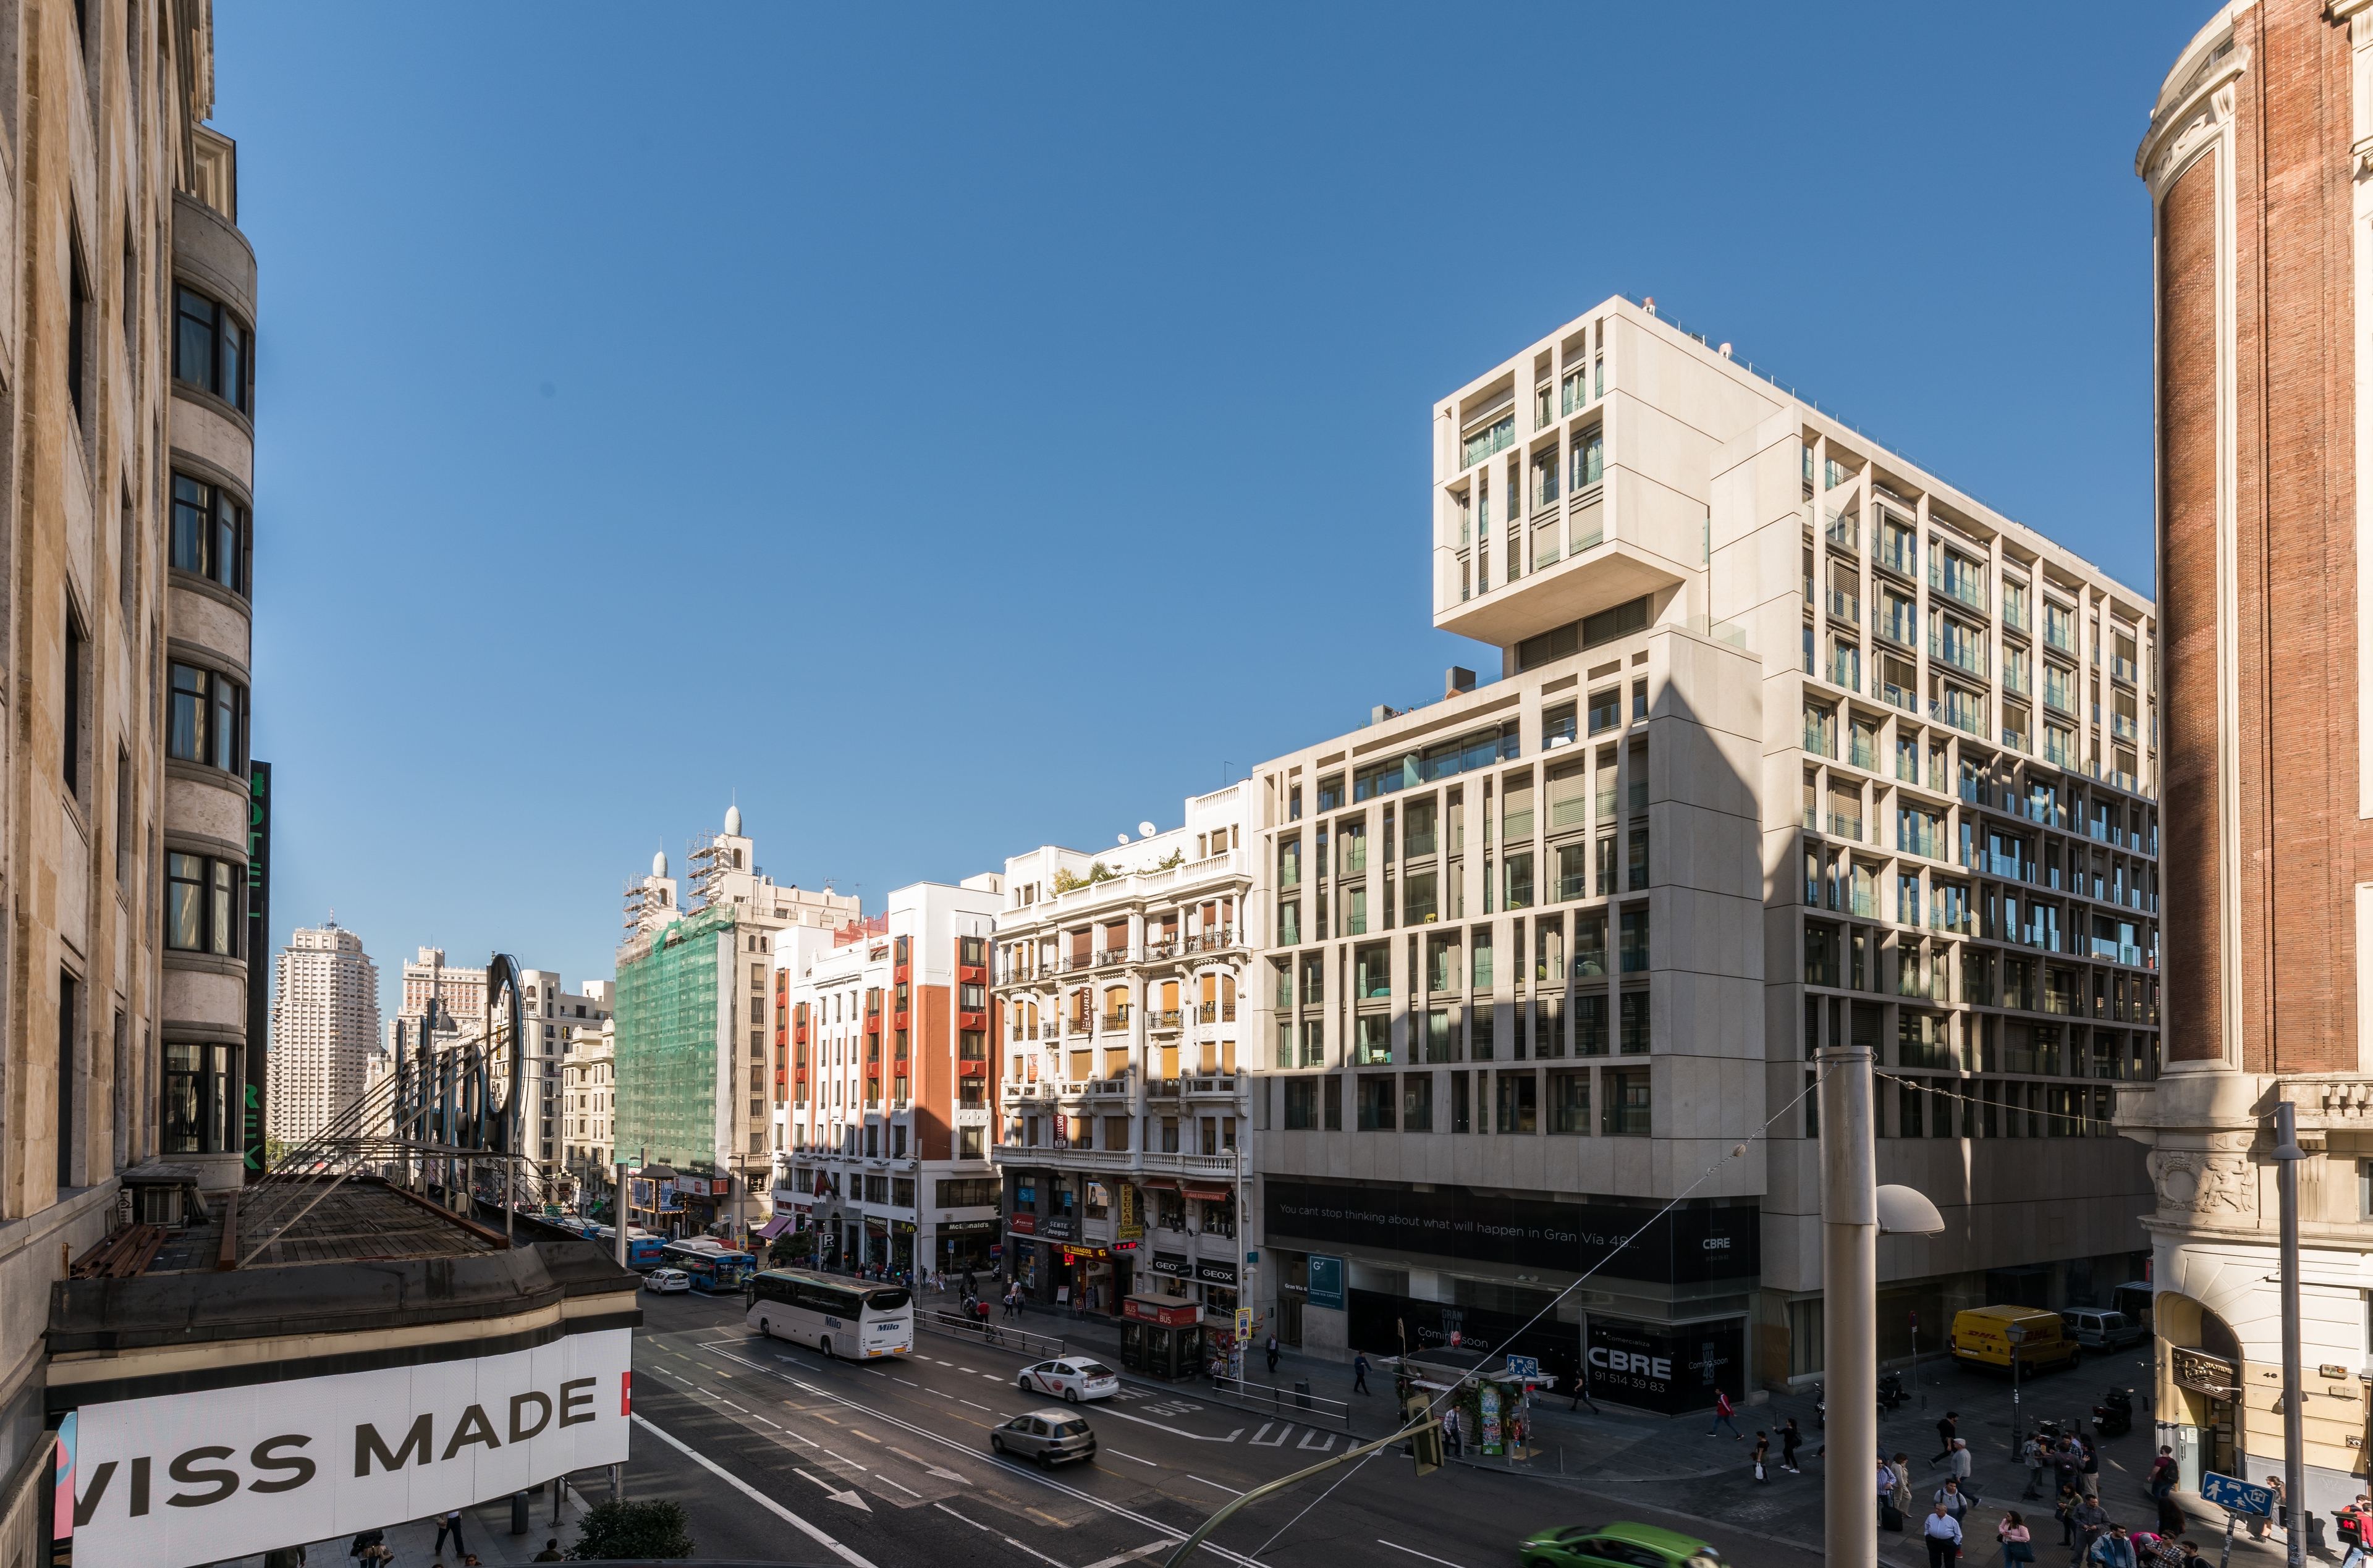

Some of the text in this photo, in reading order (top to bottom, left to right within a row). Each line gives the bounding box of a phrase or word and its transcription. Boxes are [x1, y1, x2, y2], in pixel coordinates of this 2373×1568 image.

[249, 772, 263, 918] HOTE
[1123, 1185, 1131, 1225] PELUCAS
[867, 1217, 887, 1226] McDonald's
[949, 1222, 989, 1230] McDnald's
[1280, 1204, 1296, 1214] You
[1299, 1206, 1319, 1216] cant
[1321, 1209, 1342, 1219] stop
[1345, 1210, 1385, 1224] thinking
[1388, 1215, 1420, 1226] about
[1423, 1219, 1450, 1229] what
[1454, 1221, 1473, 1232] will
[1477, 1222, 1524, 1237] happen
[1528, 1227, 1539, 1239] in
[1544, 1229, 1576, 1242] Gran
[1581, 1232, 1604, 1245] Vía
[1047, 1228, 1069, 1237] Juegos
[824, 1234, 834, 1246] P
[1703, 1237, 1730, 1249] CBRE
[1070, 1246, 1092, 1255] TABACOS
[1155, 1261, 1178, 1270] GEO
[1203, 1268, 1233, 1281] GEOX
[1125, 1304, 1136, 1312] BUS
[1159, 1315, 1172, 1324] BUS
[1442, 1309, 1463, 1322] GRAN
[825, 1316, 841, 1329] Milo
[877, 1323, 899, 1331] Milo
[1418, 1326, 1488, 1348] Comin soon
[1607, 1334, 1650, 1347] Comercializa
[1702, 1341, 1714, 1351] GRAN
[1588, 1346, 1672, 1380] CBRE
[1688, 1356, 1728, 1370] Coming soon
[2203, 1361, 2234, 1375] QUOTIDIE
[1594, 1371, 1665, 1393] 91 514 39 83
[1140, 1401, 1204, 1417] BUS
[354, 1376, 596, 1478] MADE
